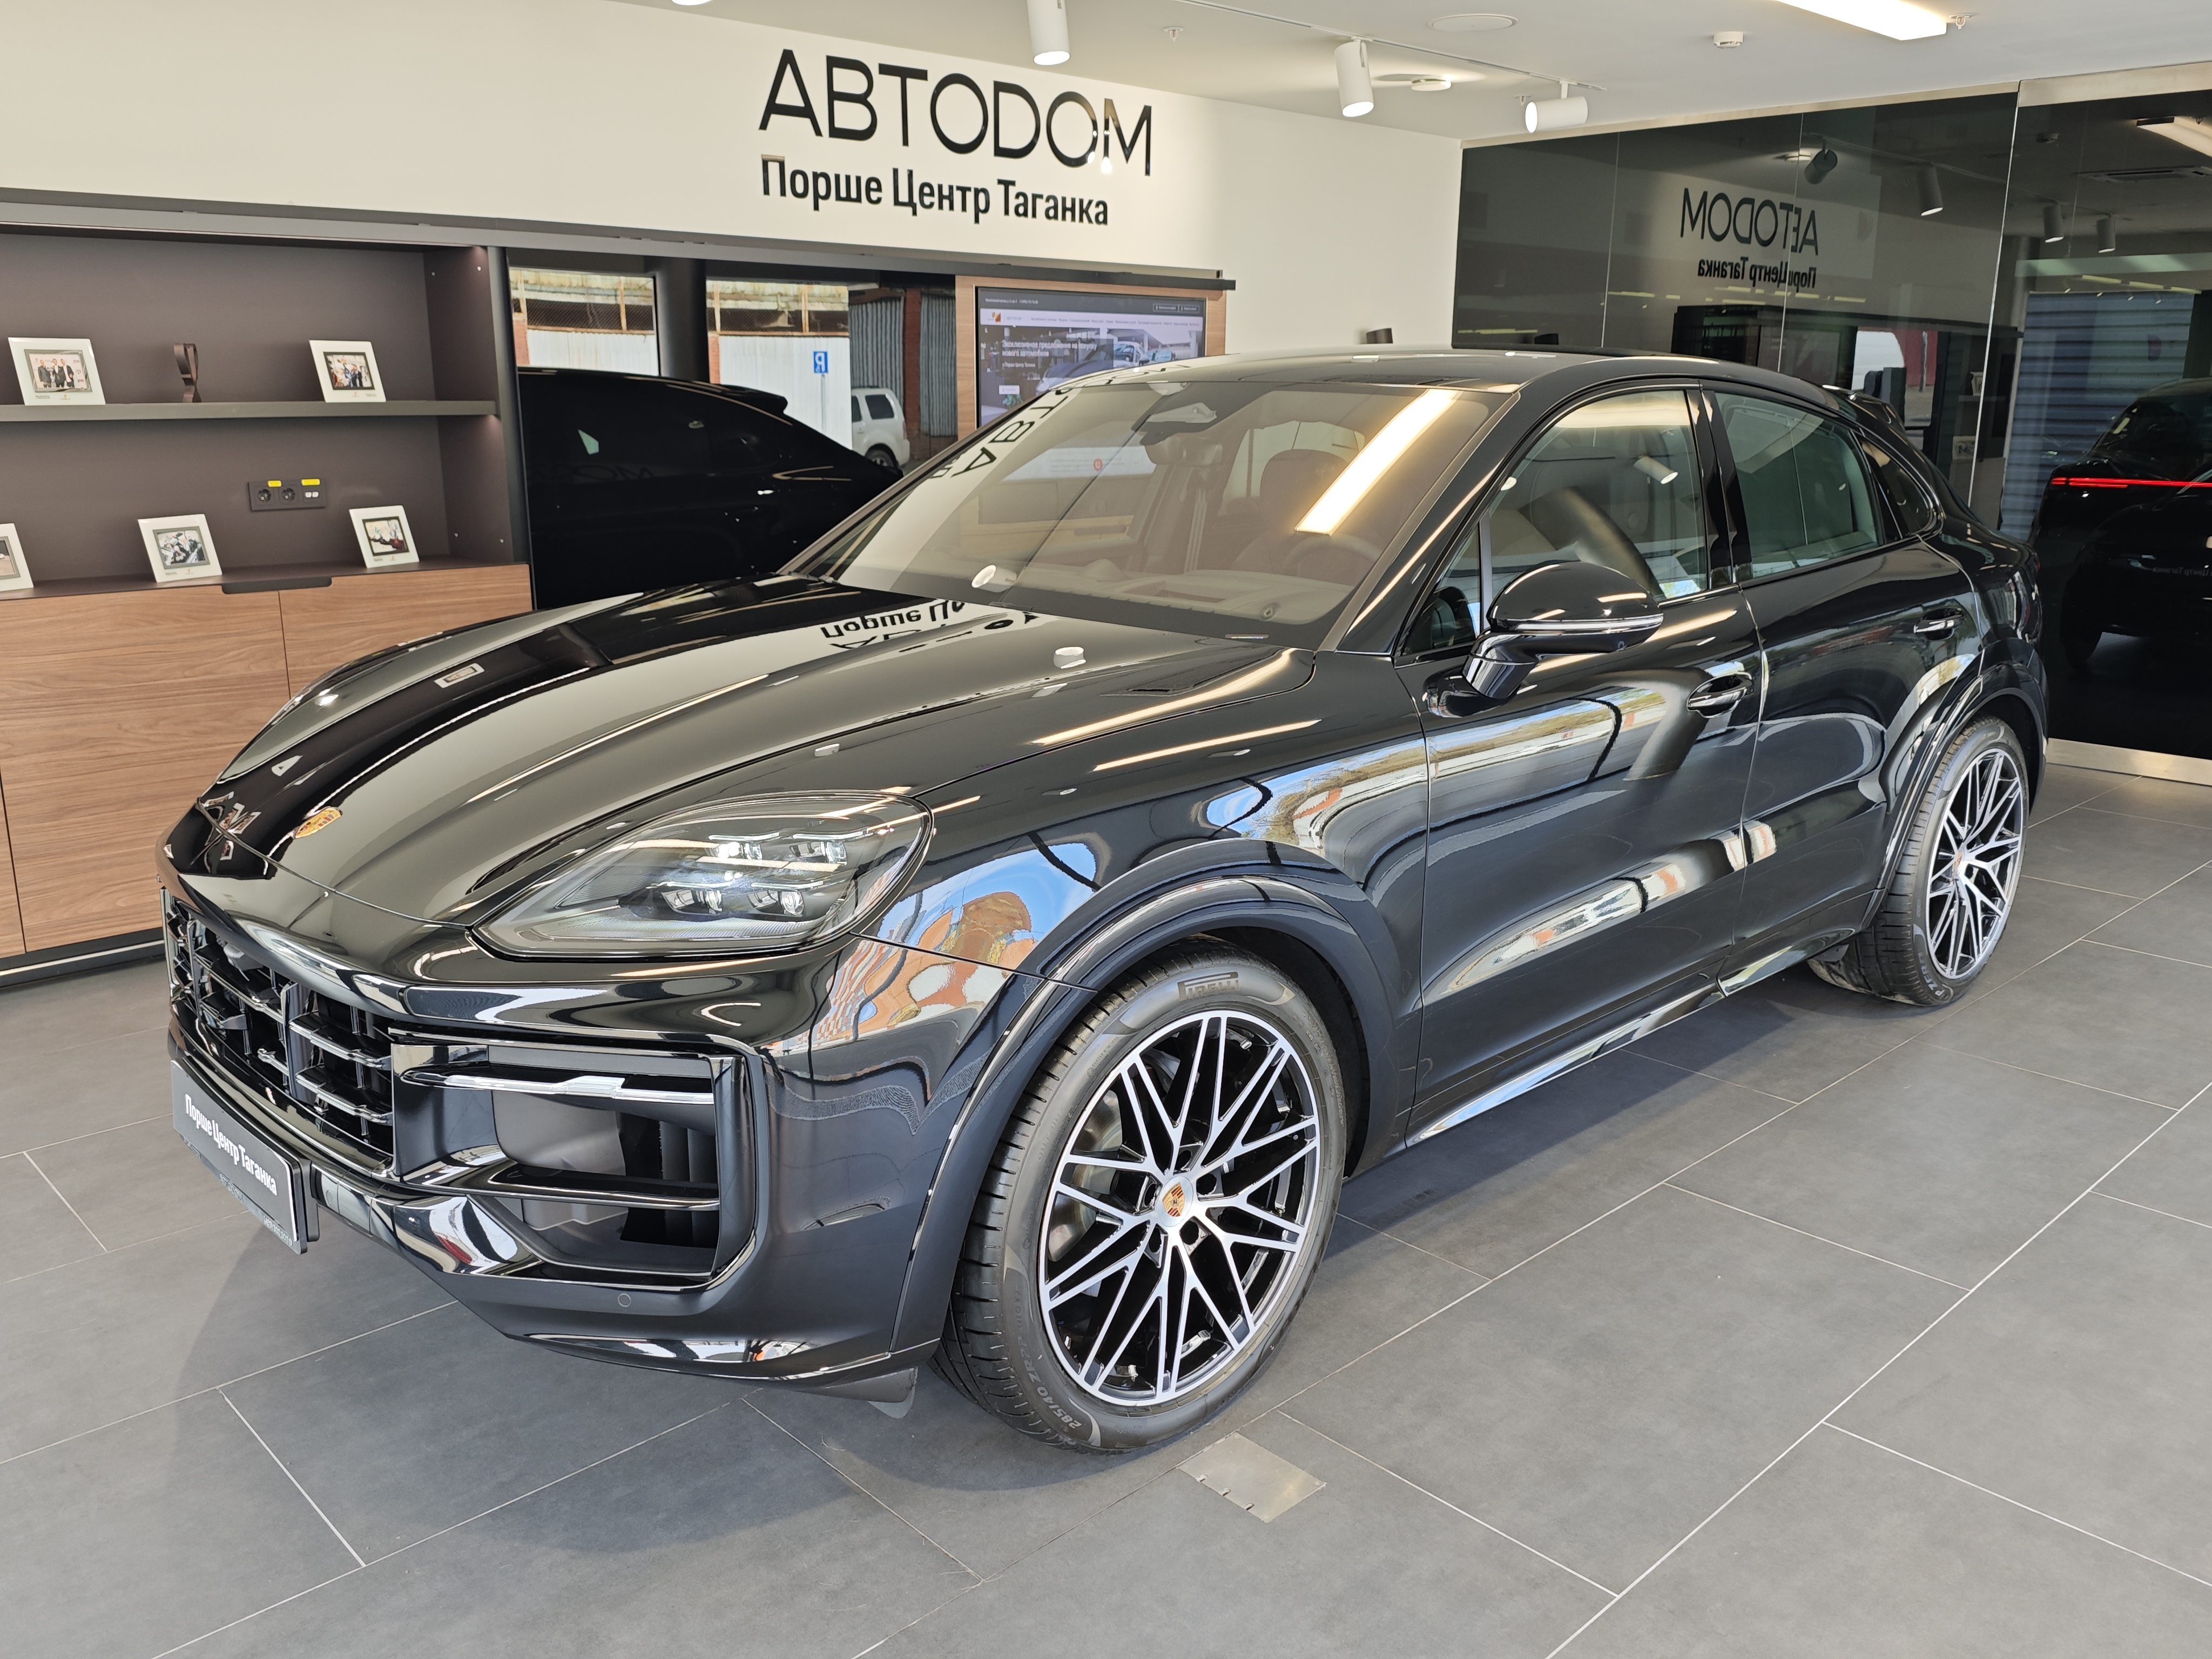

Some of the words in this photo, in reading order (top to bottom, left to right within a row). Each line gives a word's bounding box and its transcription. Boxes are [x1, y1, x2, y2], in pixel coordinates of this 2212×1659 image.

[761, 154, 882, 211] Порше
[892, 167, 990, 224] Центр
[997, 179, 1109, 225] Таганка
[1177, 972, 1239, 1002] PIRELLI
[185, 1093, 212, 1136] Порше
[212, 1119, 240, 1165] Центр
[238, 1144, 278, 1196] Таганка
[1037, 1386, 1082, 1429] 285/40
